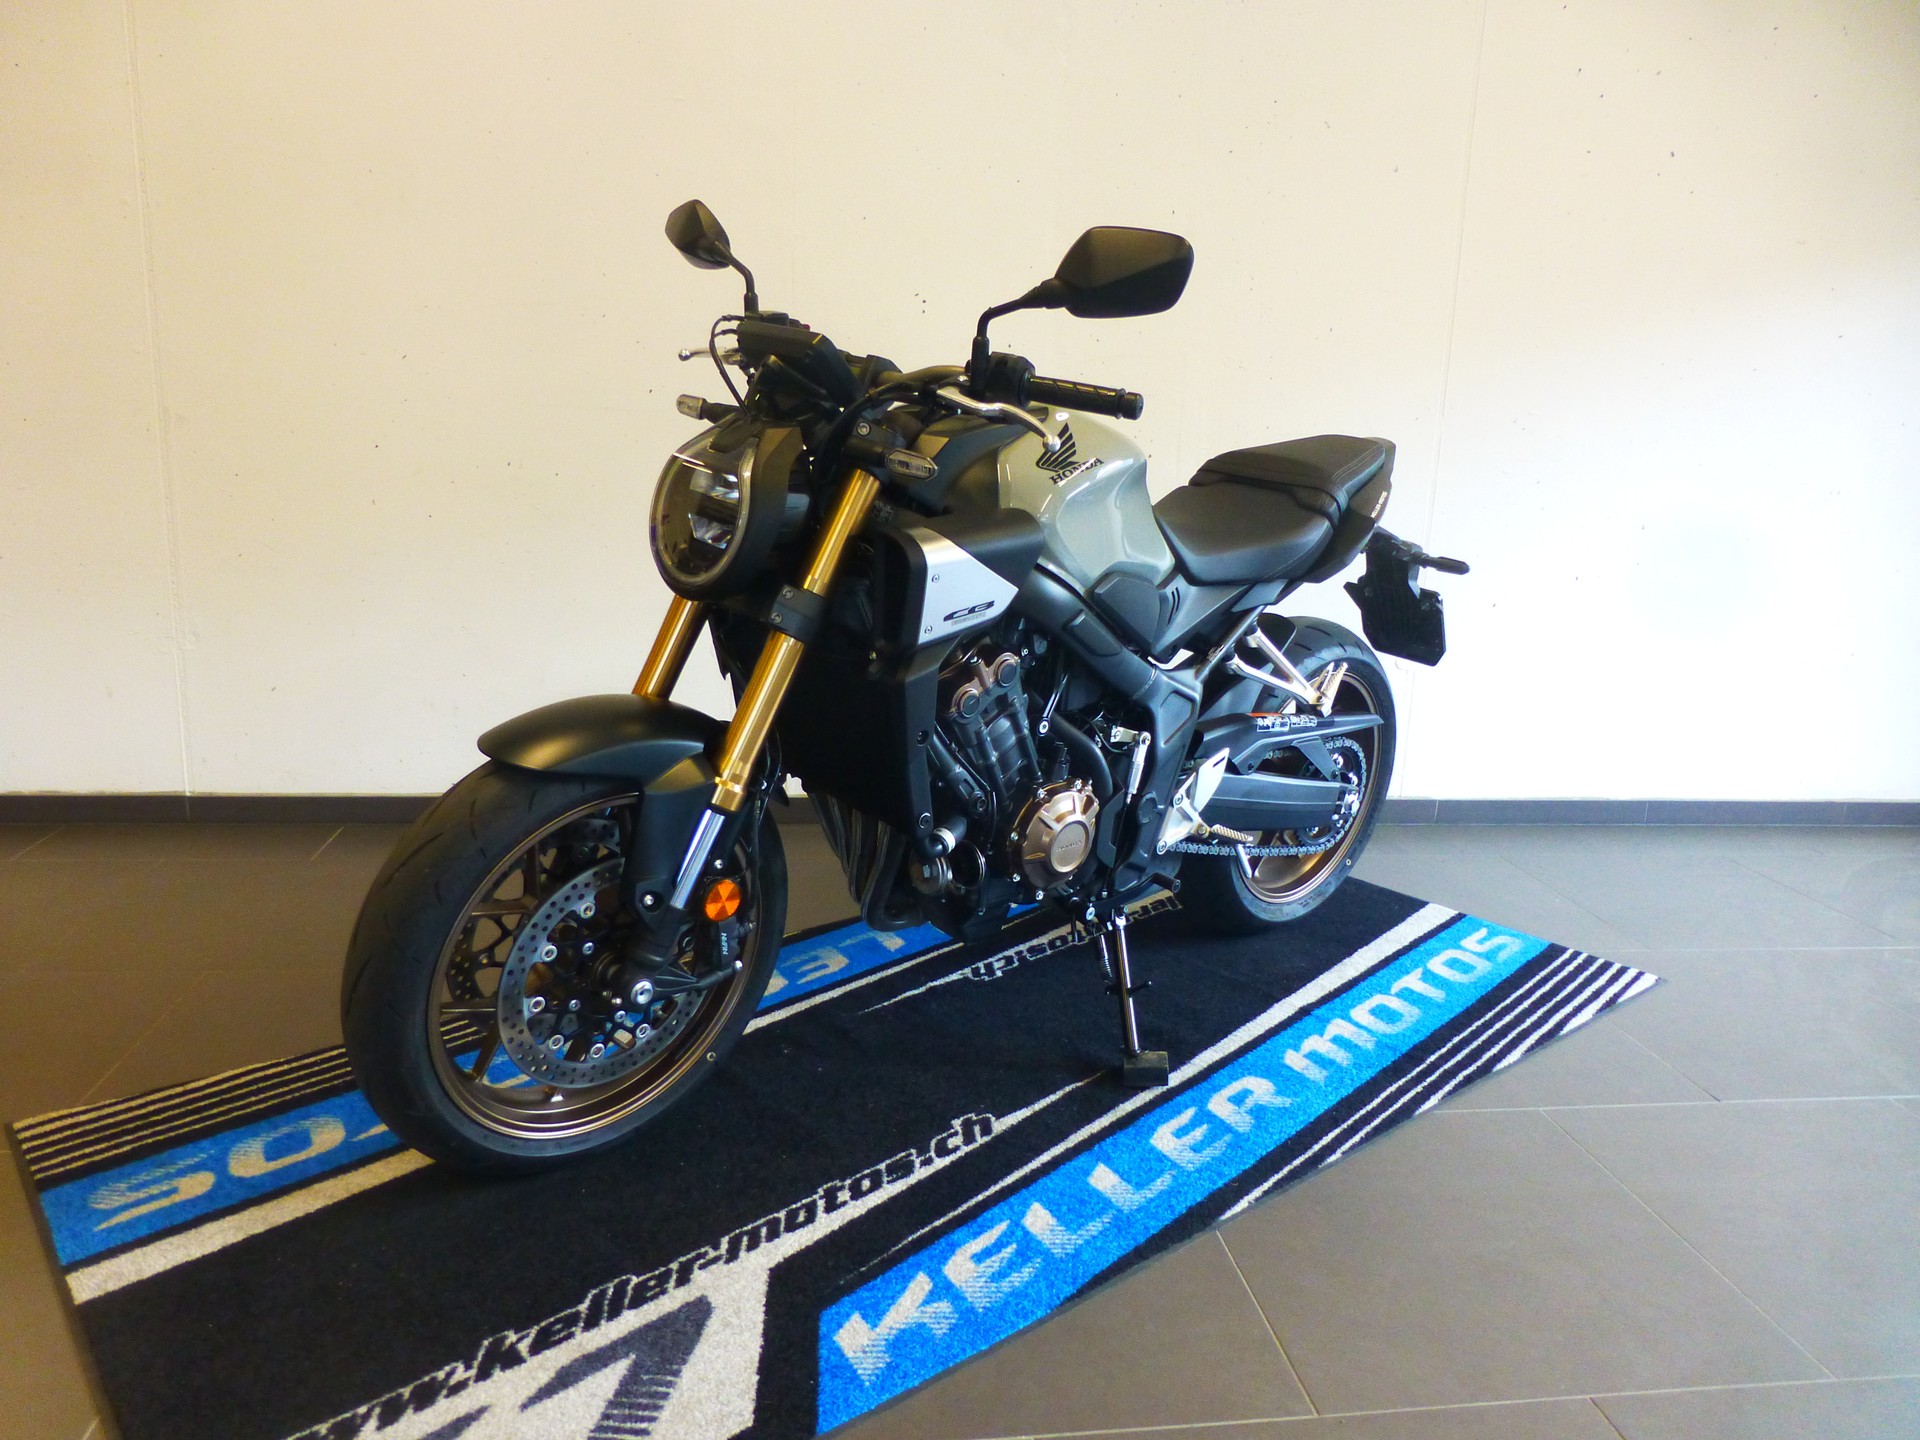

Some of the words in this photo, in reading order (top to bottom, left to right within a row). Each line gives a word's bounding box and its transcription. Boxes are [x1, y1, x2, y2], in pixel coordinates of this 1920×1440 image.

[1049, 458, 1104, 485] HONDA
[943, 600, 995, 622] CB
[833, 1077, 1293, 1386] KELLER
[1284, 926, 1524, 1086] MOTOS
